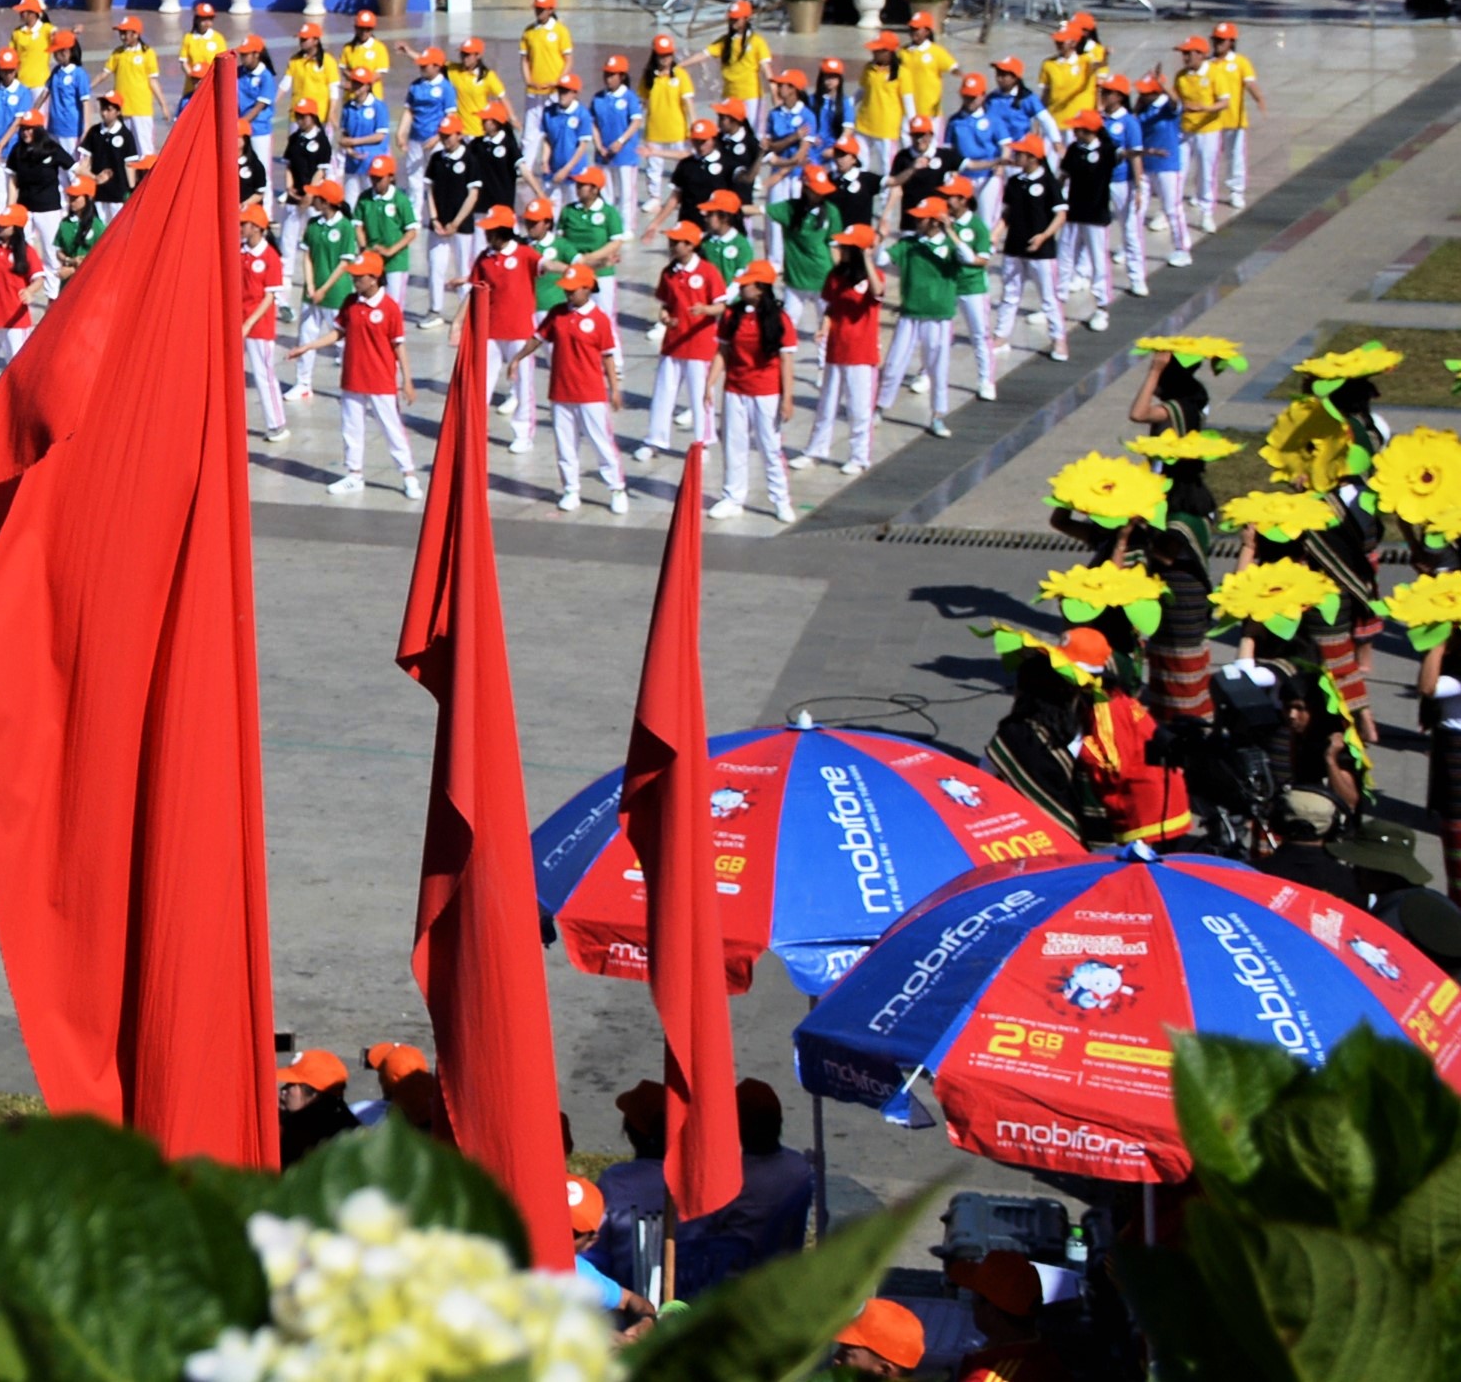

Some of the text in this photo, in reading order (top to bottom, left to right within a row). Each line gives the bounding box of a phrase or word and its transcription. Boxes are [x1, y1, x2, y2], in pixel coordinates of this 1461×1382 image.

[541, 783, 624, 869] mobi
[819, 765, 891, 914] mobifone
[868, 889, 1037, 1033] mobifone
[822, 1059, 898, 1098] mobifon
[995, 1119, 1148, 1159] mobifone
